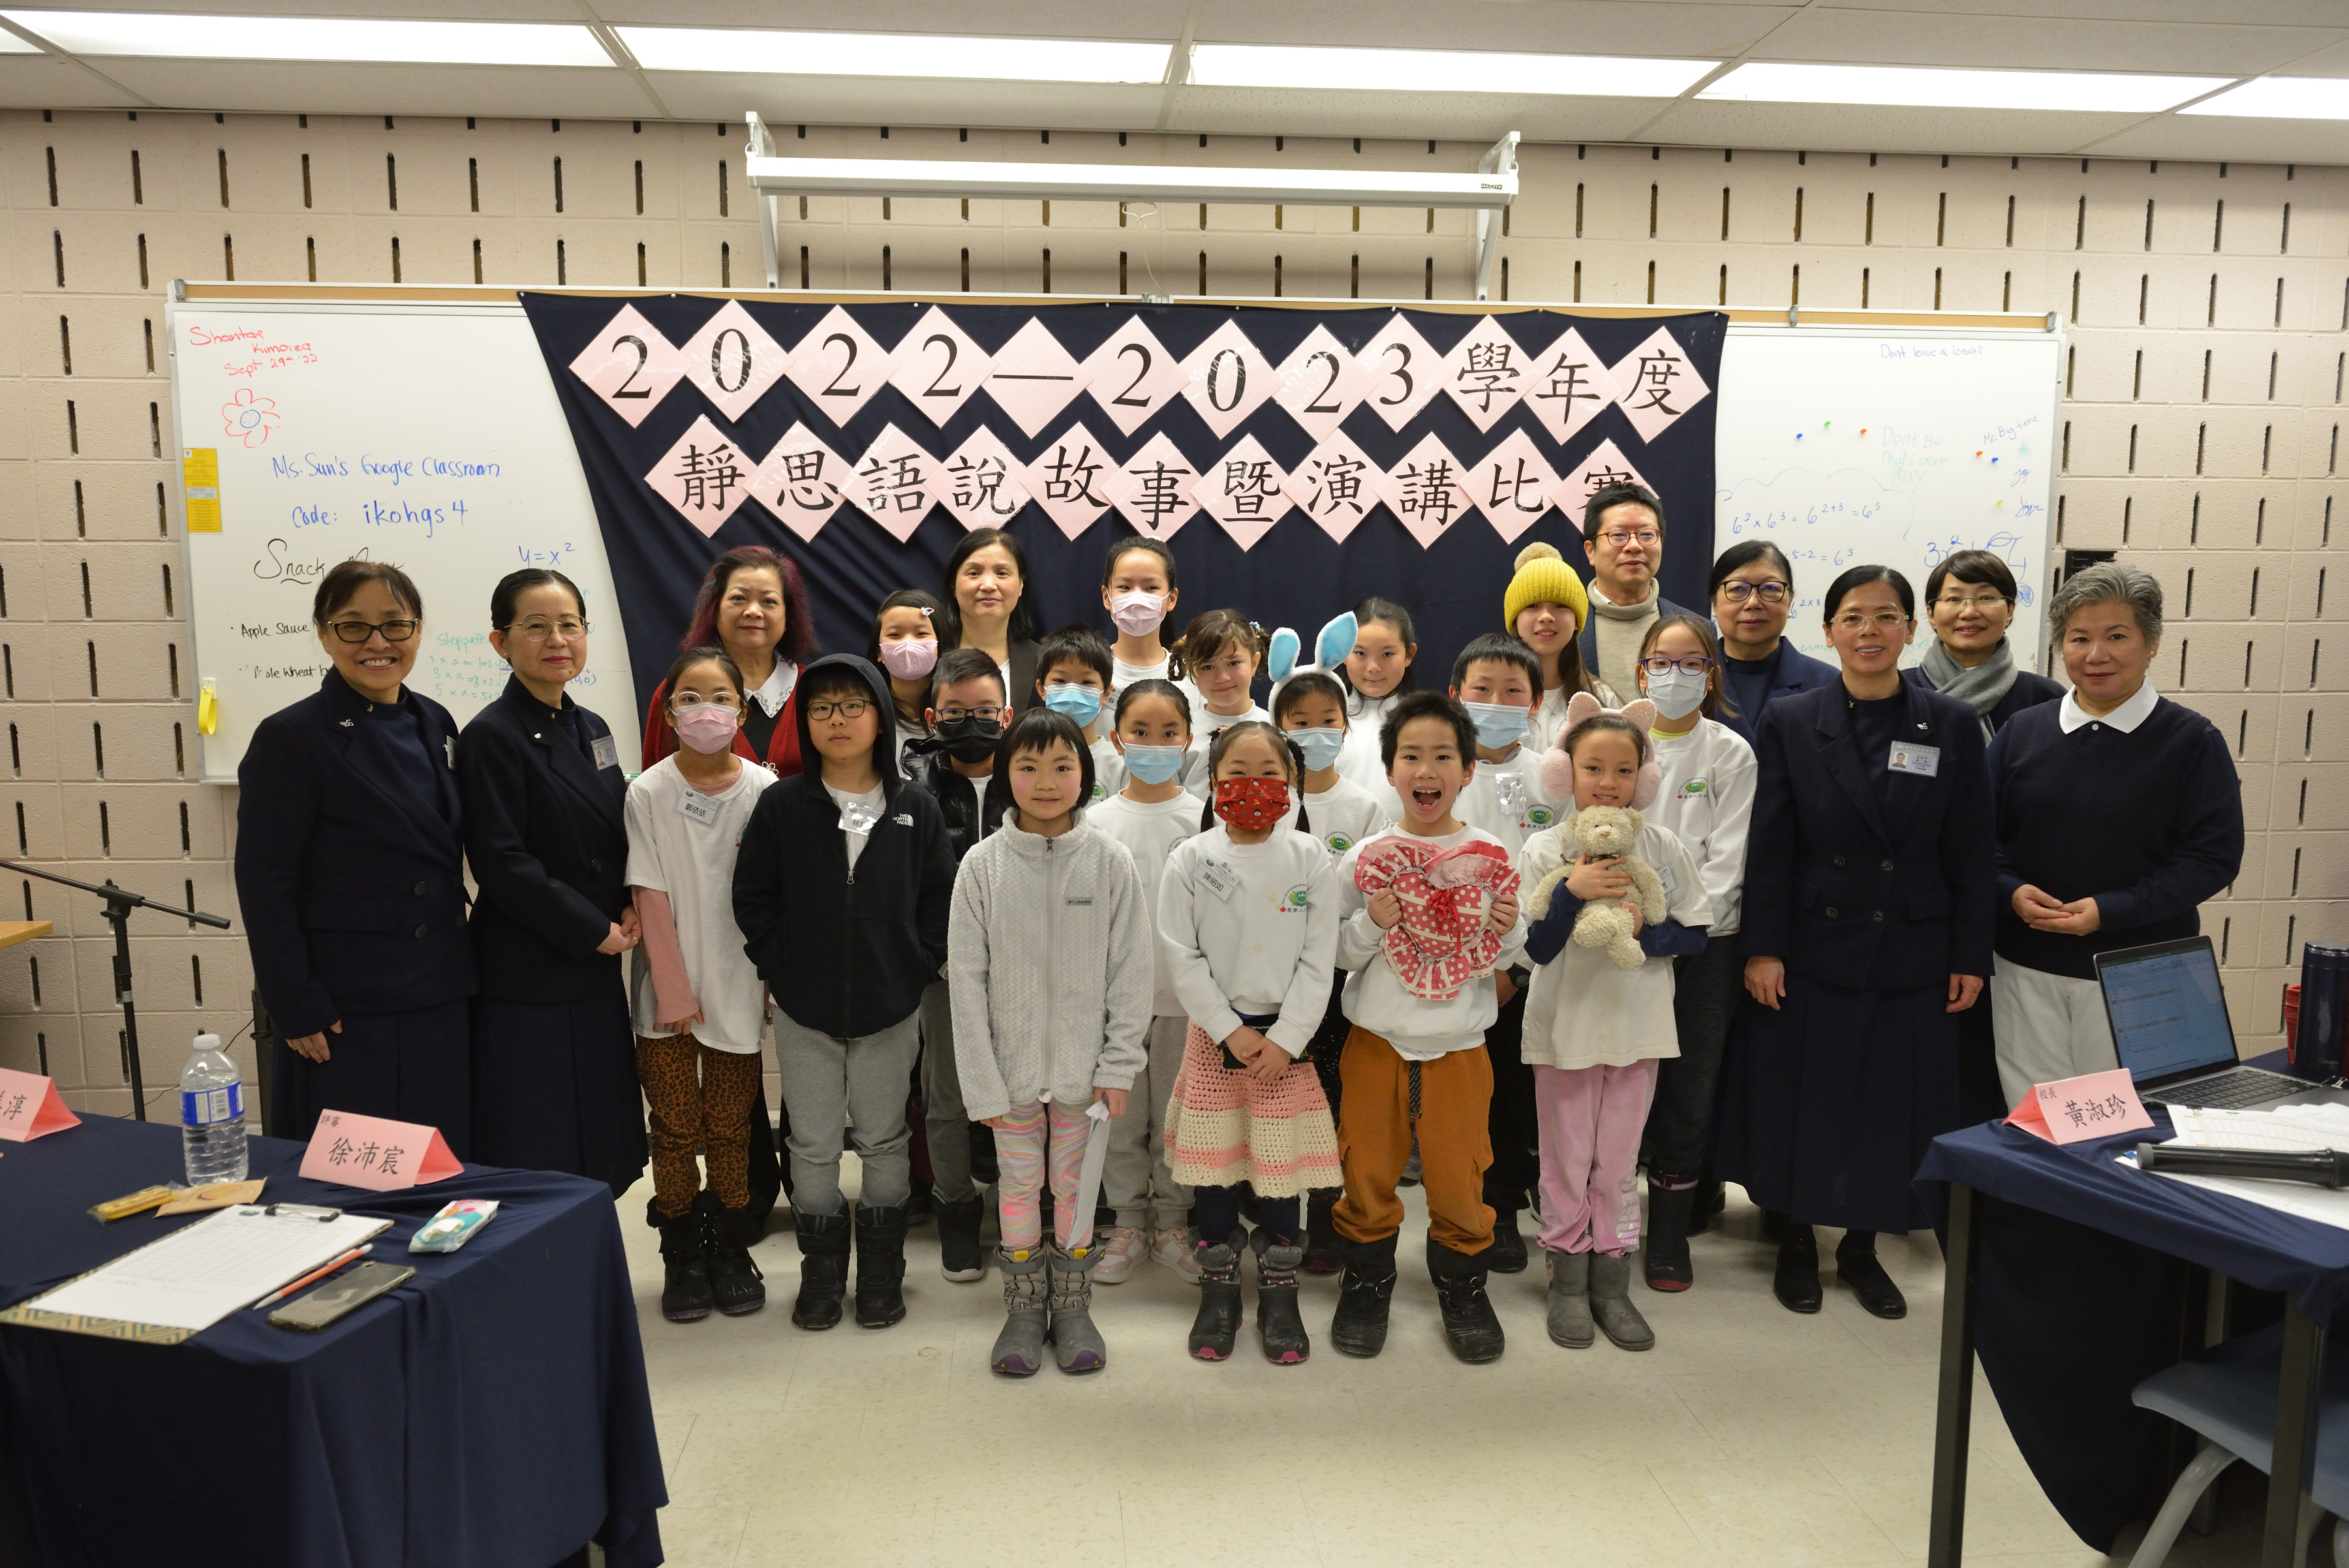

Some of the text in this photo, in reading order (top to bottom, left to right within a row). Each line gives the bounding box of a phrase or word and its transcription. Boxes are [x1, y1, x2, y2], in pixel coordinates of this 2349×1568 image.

[1881, 344, 1907, 359] Dont
[1913, 346, 1936, 357] leave
[224, 359, 263, 378] Sept
[1998, 425, 2016, 440] Big
[273, 455, 303, 478] Ms.
[305, 453, 348, 477] Sun's
[361, 453, 414, 485] Google
[292, 504, 337, 528] Code:
[254, 538, 326, 579] Snack
[241, 624, 271, 639] Apple
[1203, 872, 1224, 891] 陳昭如
[2039, 1086, 2057, 1100] 校長
[2065, 1094, 2126, 1129] 黃淑珍
[321, 1115, 341, 1128] 評審
